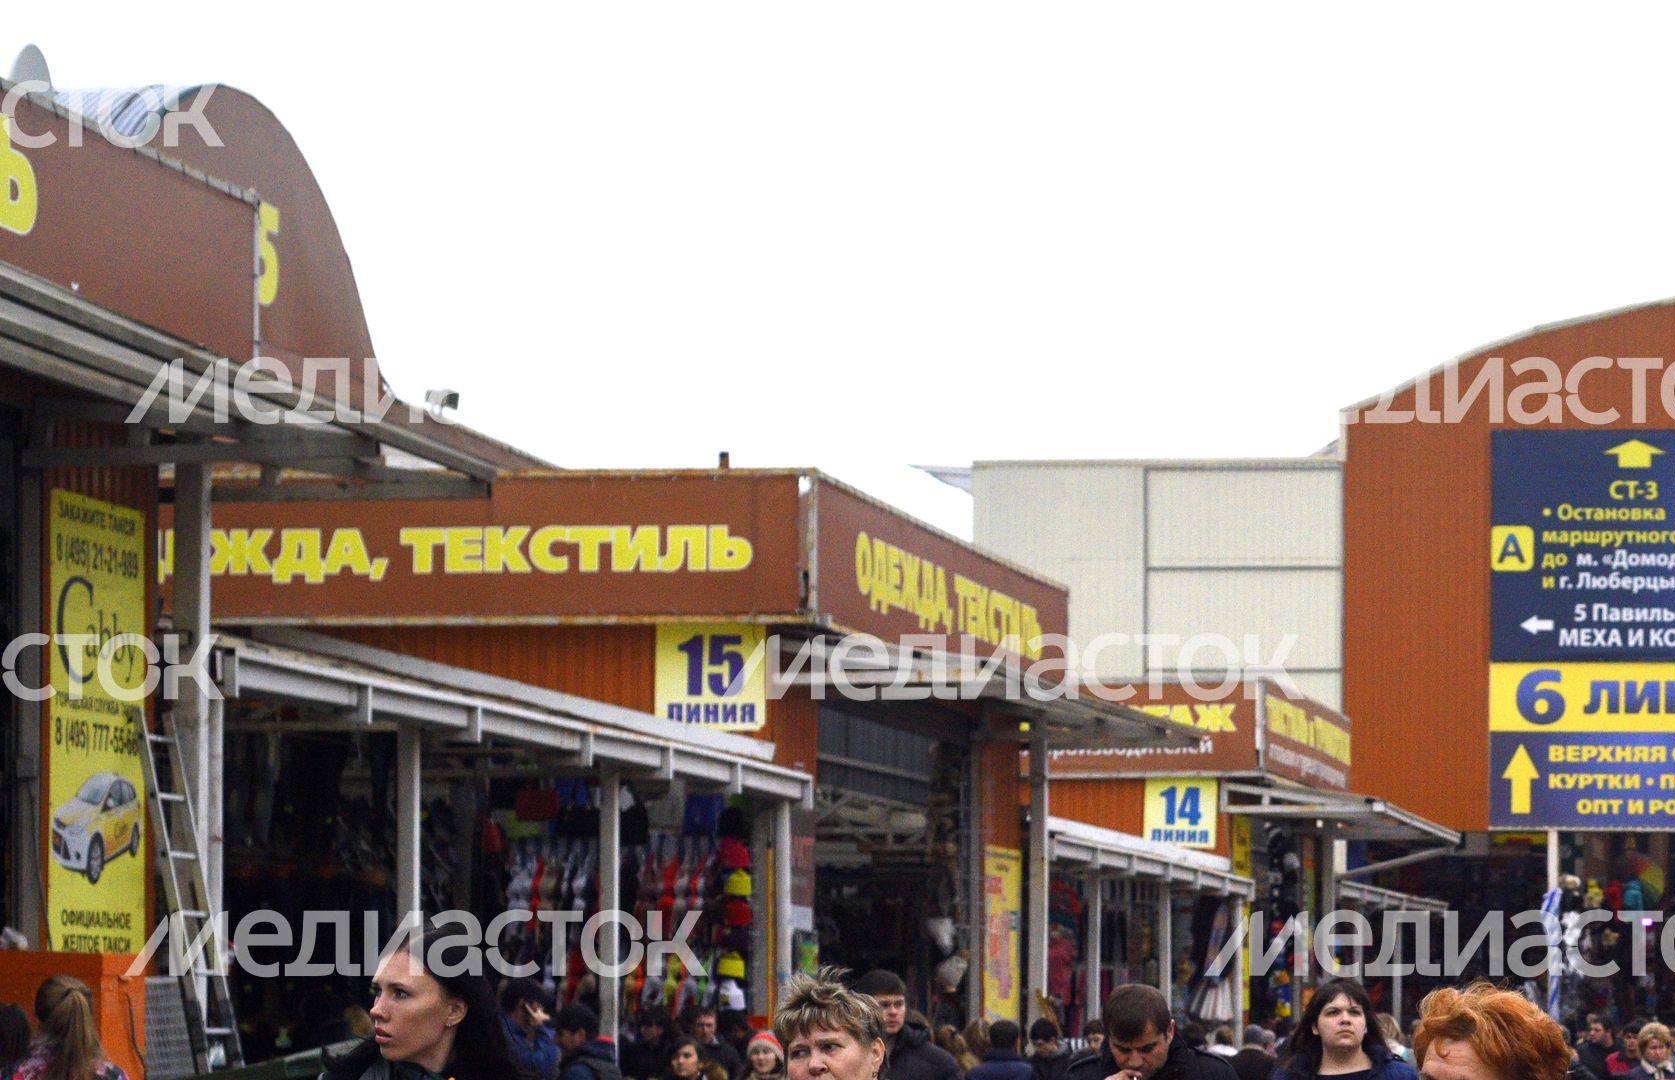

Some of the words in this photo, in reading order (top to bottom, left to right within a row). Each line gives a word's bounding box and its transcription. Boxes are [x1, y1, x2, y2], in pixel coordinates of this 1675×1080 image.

[1609, 481, 1658, 500] СТ-3
[1557, 503, 1666, 521] Остановка
[400, 524, 753, 576] ТЕКСТИЛЬ
[1542, 554, 1568, 570] до
[1576, 554, 1598, 567] м.
[855, 531, 953, 635] ОДЕЖДА,
[1542, 576, 1555, 589] и
[1559, 576, 1573, 589] г.
[1577, 572, 1675, 593] Люберцы
[1574, 603, 1588, 622] 5
[1559, 628, 1623, 647] МЕХА
[1627, 628, 1644, 647] И
[677, 633, 746, 697] 15
[1516, 669, 1566, 725] 6
[667, 701, 757, 723] ЛИНИЯ
[1548, 745, 1666, 763] ВЕРХНЯЯ
[1548, 773, 1641, 790] КУРТКИ
[1160, 786, 1202, 826] 14
[1577, 799, 1623, 815] ОПТ
[1627, 799, 1644, 815] И
[61, 909, 132, 930] ОФИЦИАЛЬНОЕ
